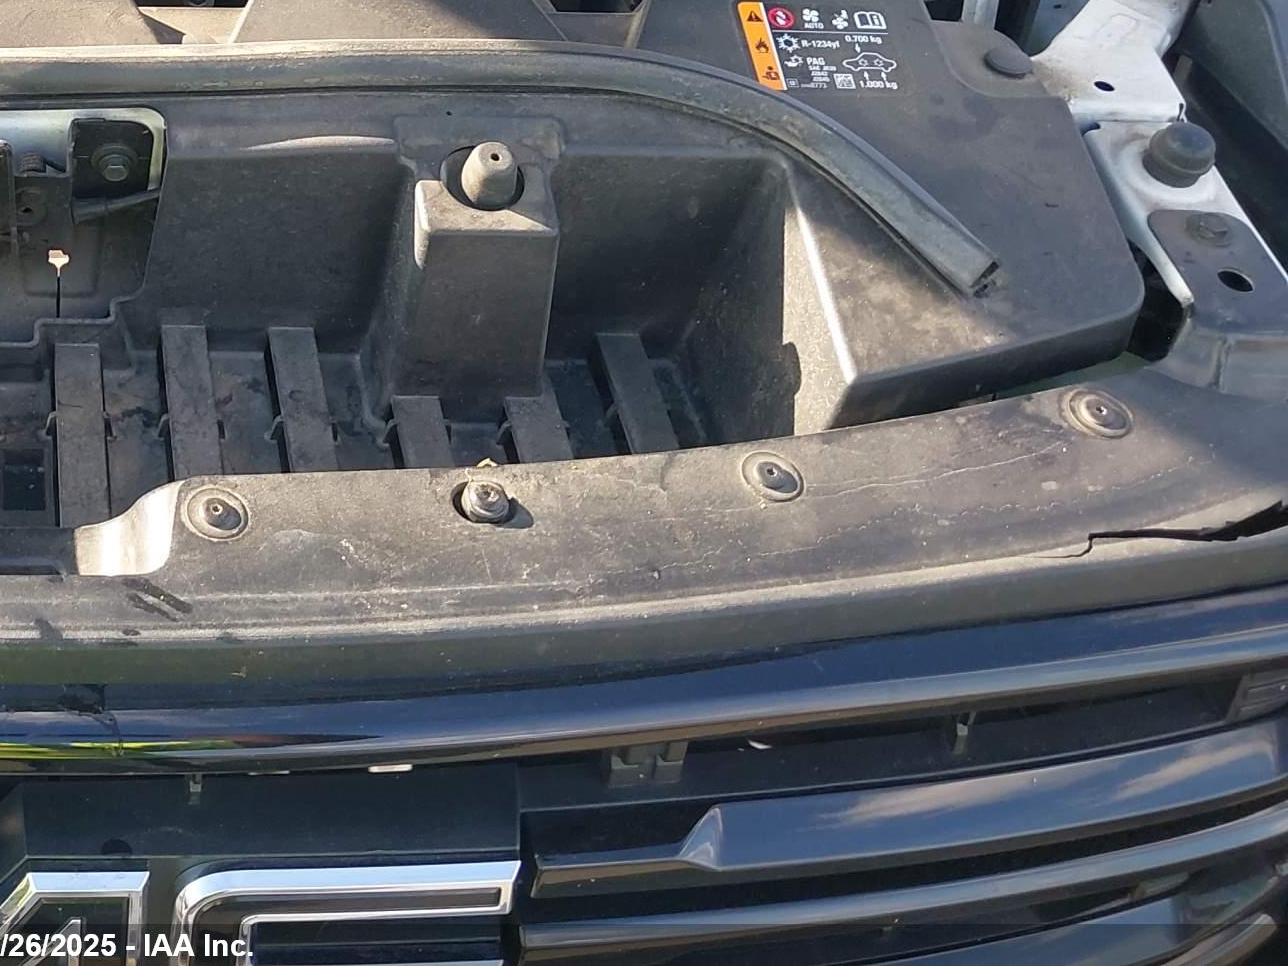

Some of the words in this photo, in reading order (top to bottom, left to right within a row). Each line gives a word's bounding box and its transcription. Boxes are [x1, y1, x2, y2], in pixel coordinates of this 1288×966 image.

[801, 39, 840, 50] R-1234yf
[869, 35, 883, 45] kg
[806, 57, 826, 66] PAG
[885, 80, 899, 90] kg
